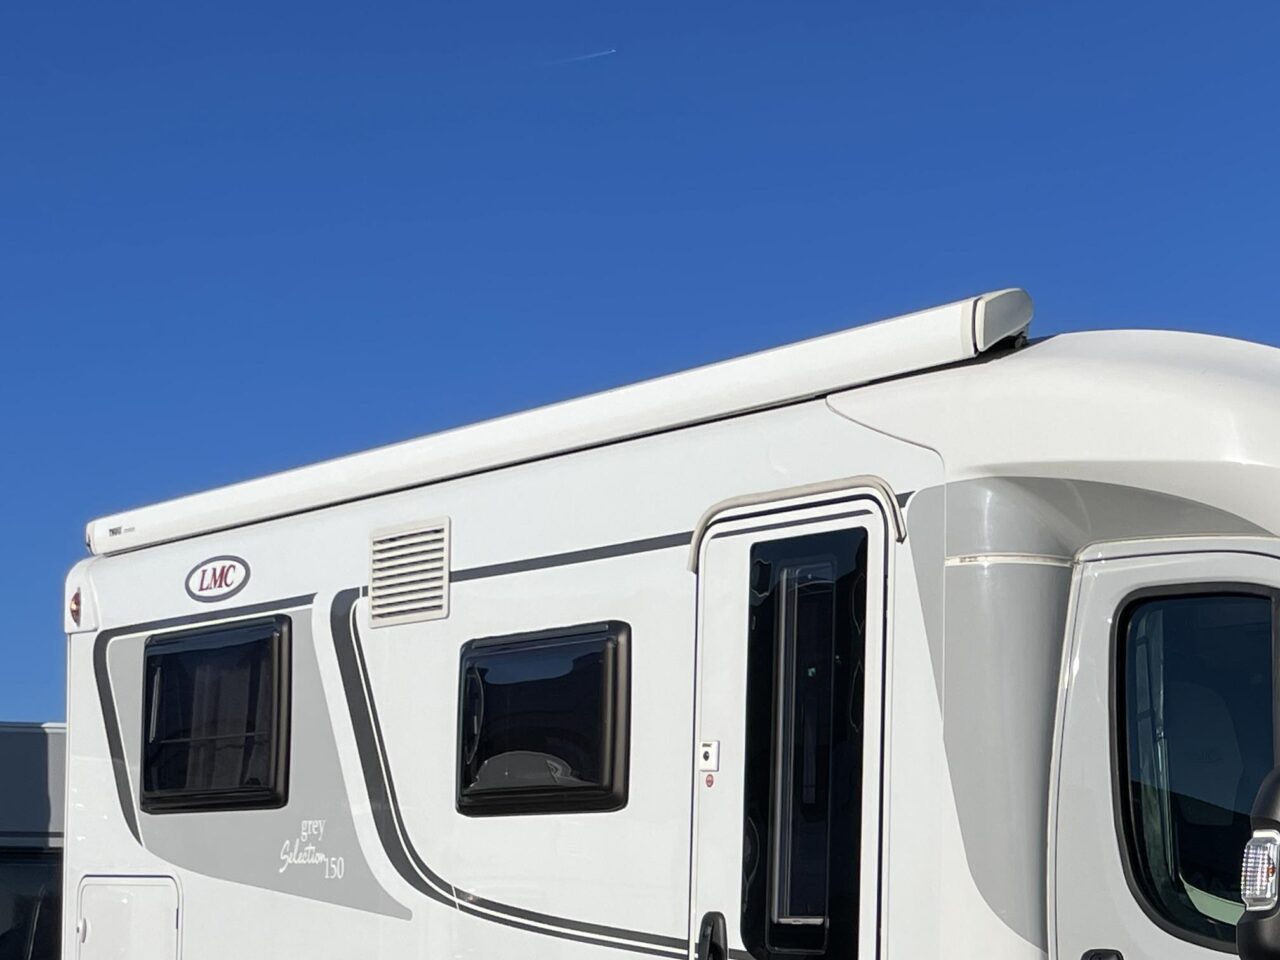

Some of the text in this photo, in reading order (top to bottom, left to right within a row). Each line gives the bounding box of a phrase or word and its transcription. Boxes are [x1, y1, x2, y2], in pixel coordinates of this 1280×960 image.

[198, 563, 236, 592] LMC
[300, 819, 326, 842] grey
[279, 838, 326, 873] Selection
[324, 856, 345, 880] 150
